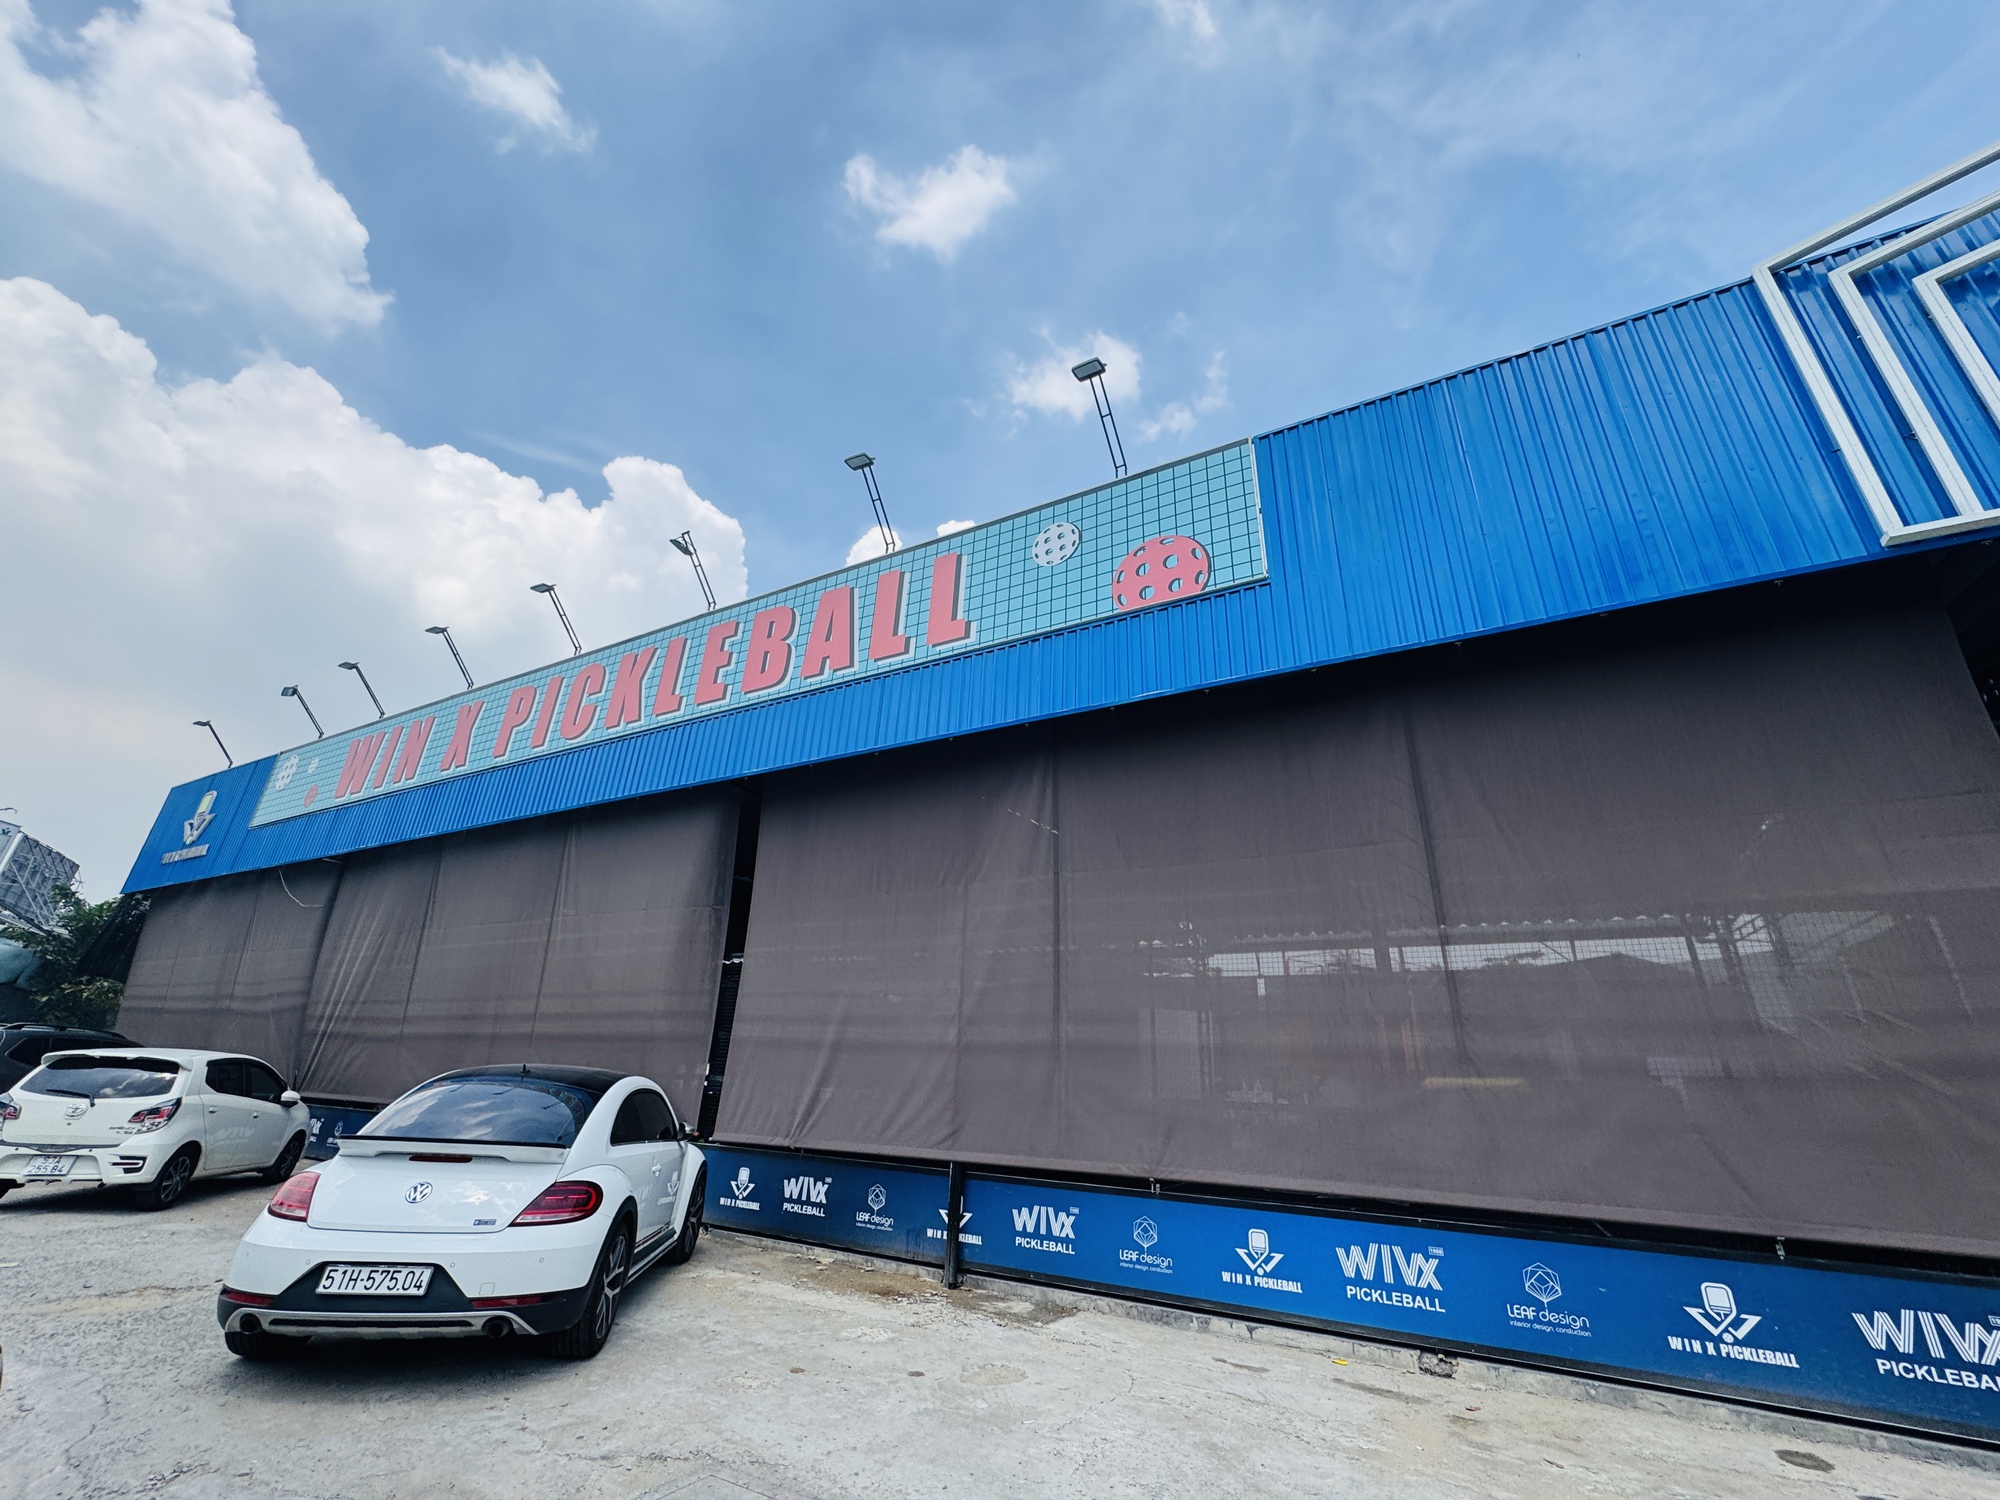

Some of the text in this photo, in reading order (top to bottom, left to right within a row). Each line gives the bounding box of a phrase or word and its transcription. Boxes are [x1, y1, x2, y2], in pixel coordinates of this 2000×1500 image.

[334, 552, 976, 800] WIN X PICKLEBALL
[782, 1202, 826, 1217] PICKLEBALL
[855, 1211, 871, 1222] LEAF
[870, 1213, 894, 1227] design
[926, 1228, 941, 1239] WIN
[958, 1232, 983, 1246] KLEBALL
[1015, 1236, 1076, 1255] PICKLEBALL
[1119, 1249, 1173, 1269] LEAF design
[322, 1268, 425, 1292] 51H-575.04
[1221, 1270, 1304, 1294] WIN X PICKLEBALL
[1346, 1285, 1446, 1314] PICKLEBALL
[1506, 1303, 1590, 1330] LEAF design
[1667, 1335, 1801, 1369] WIN X PICKLEBALL
